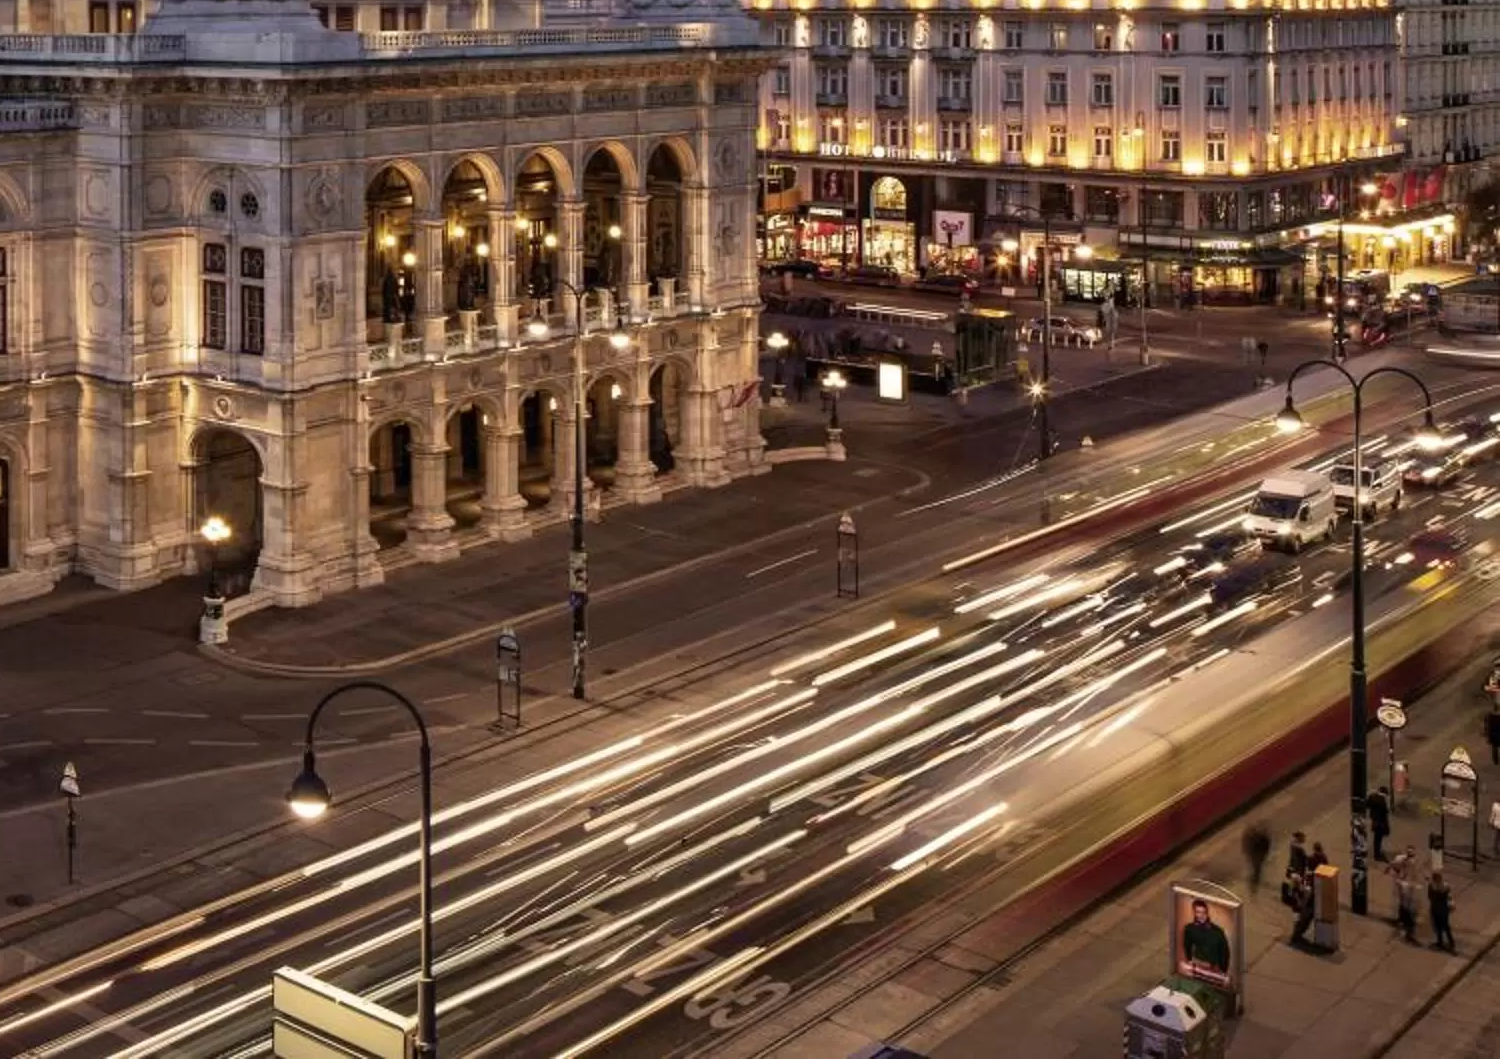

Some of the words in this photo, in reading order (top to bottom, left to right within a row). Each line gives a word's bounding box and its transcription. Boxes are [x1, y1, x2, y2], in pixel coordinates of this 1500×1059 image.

[819, 142, 873, 157] HOTL
[887, 145, 957, 163] BRIOL
[621, 941, 792, 1030] GRZ
